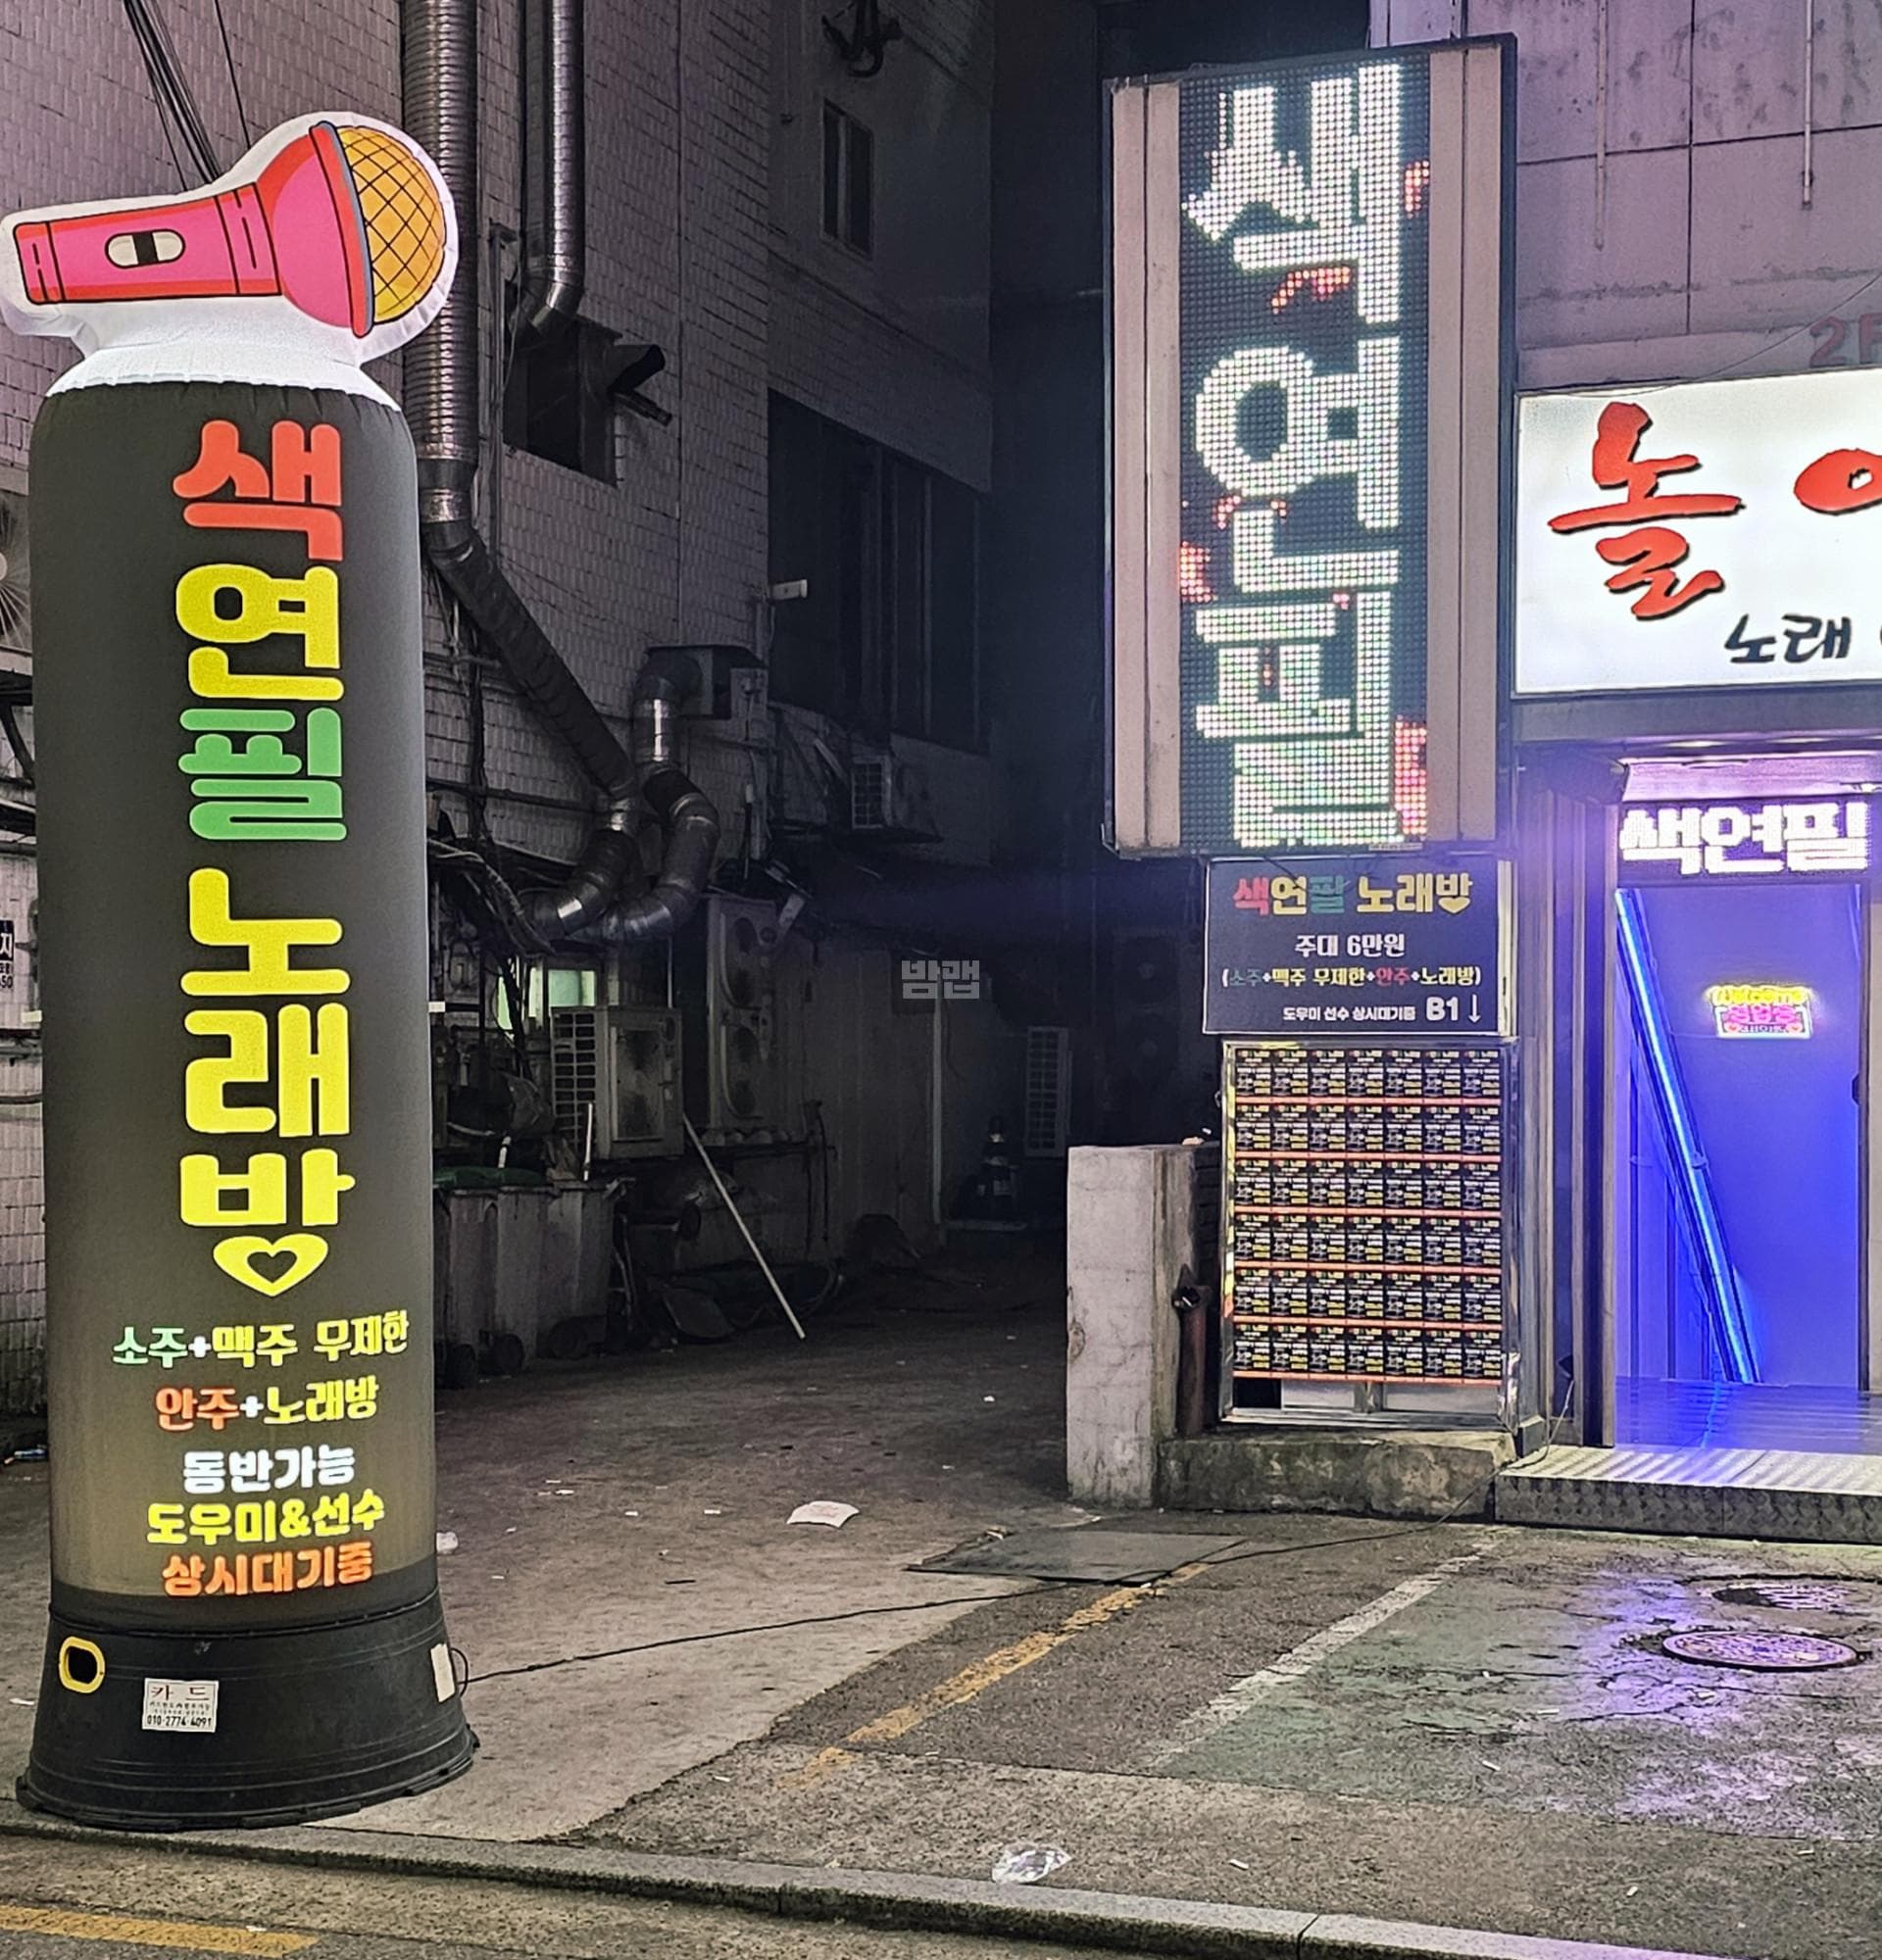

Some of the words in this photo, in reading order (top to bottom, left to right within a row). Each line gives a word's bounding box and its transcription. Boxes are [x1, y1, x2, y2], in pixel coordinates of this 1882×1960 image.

[1182, 61, 1403, 848] 색연필
[173, 419, 347, 841] 색연필
[1724, 612, 1852, 663] 노래
[1619, 802, 1869, 874] 색연필
[1357, 872, 1473, 914] 노래방
[1294, 935, 1339, 957] 주대
[1347, 933, 1405, 957] 6만원
[1282, 1006, 1321, 1022] 도우미
[1323, 1006, 1350, 1022] 선수
[1425, 996, 1460, 1021] B1
[180, 867, 356, 1297] 노래방
[112, 1323, 298, 1368] 소주+맥주
[313, 1309, 410, 1362] 무제한
[155, 1374, 379, 1431] 안주+노래방
[182, 1444, 355, 1494] 동반가능
[146, 1488, 385, 1545] 도우미&선수
[162, 1540, 373, 1597] 상시대기중
